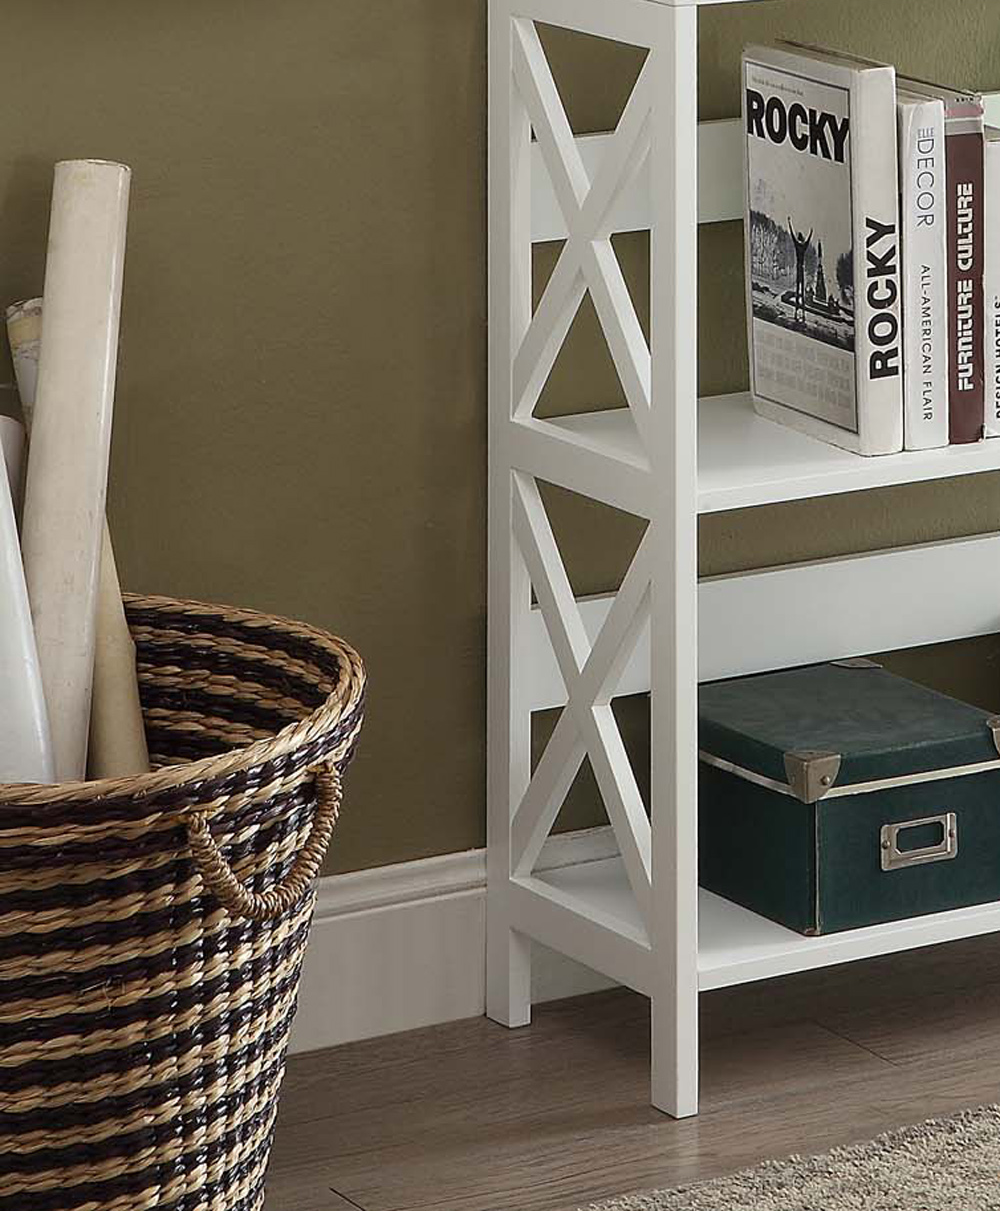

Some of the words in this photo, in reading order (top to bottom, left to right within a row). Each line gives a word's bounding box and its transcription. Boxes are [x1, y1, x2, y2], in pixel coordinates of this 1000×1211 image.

[745, 88, 850, 164] ROCKY
[917, 127, 934, 137] ELLE
[916, 138, 934, 227] DECOR
[957, 183, 973, 271] CULTURE
[865, 217, 899, 380] ROCKY
[921, 264, 932, 376] ALL-AMERICAN
[957, 279, 974, 391] FURNITURE
[923, 381, 933, 421] FLAIR
